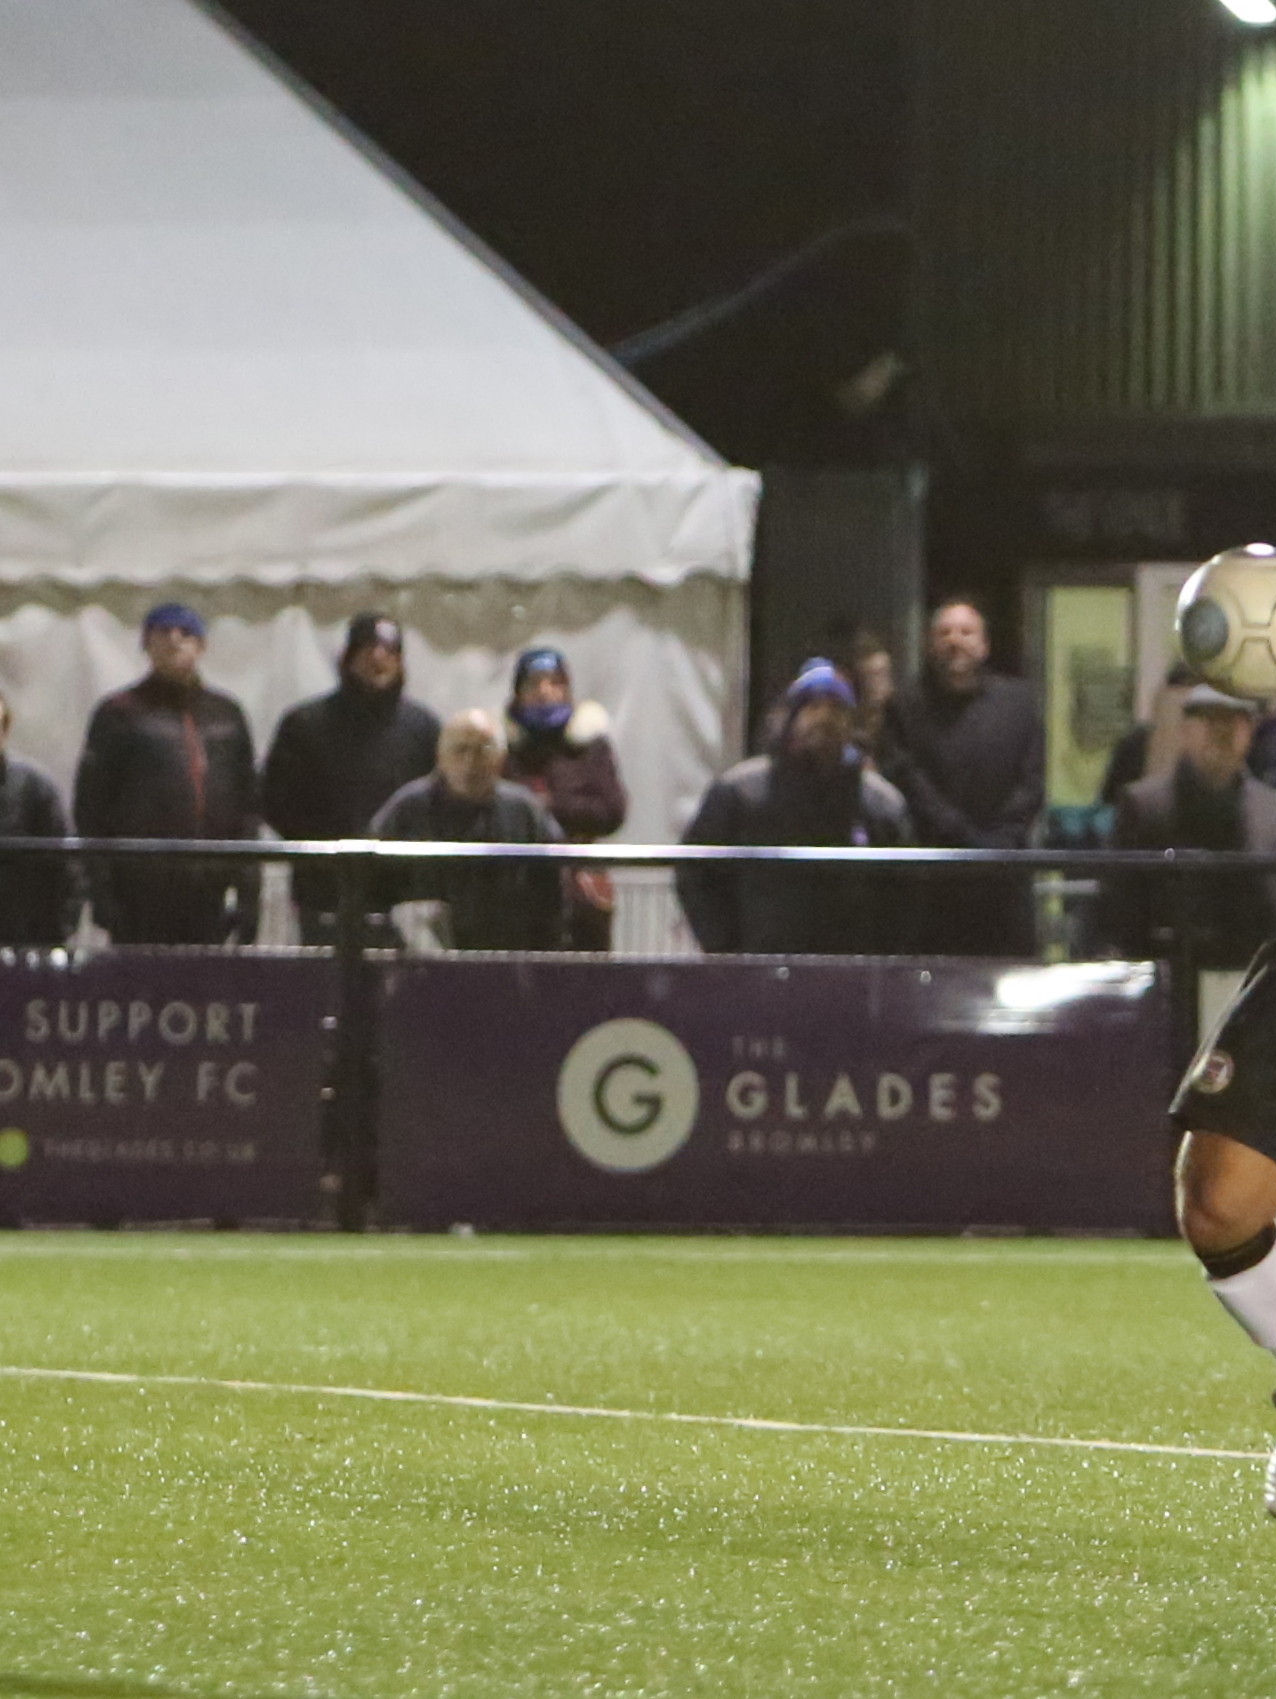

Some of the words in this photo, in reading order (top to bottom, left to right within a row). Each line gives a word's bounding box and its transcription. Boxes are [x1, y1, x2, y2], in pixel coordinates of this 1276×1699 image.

[25, 998, 258, 1043] SUPPORT
[197, 1060, 258, 1104] FC
[593, 1054, 663, 1135] G
[726, 1070, 1003, 1121] GLADES
